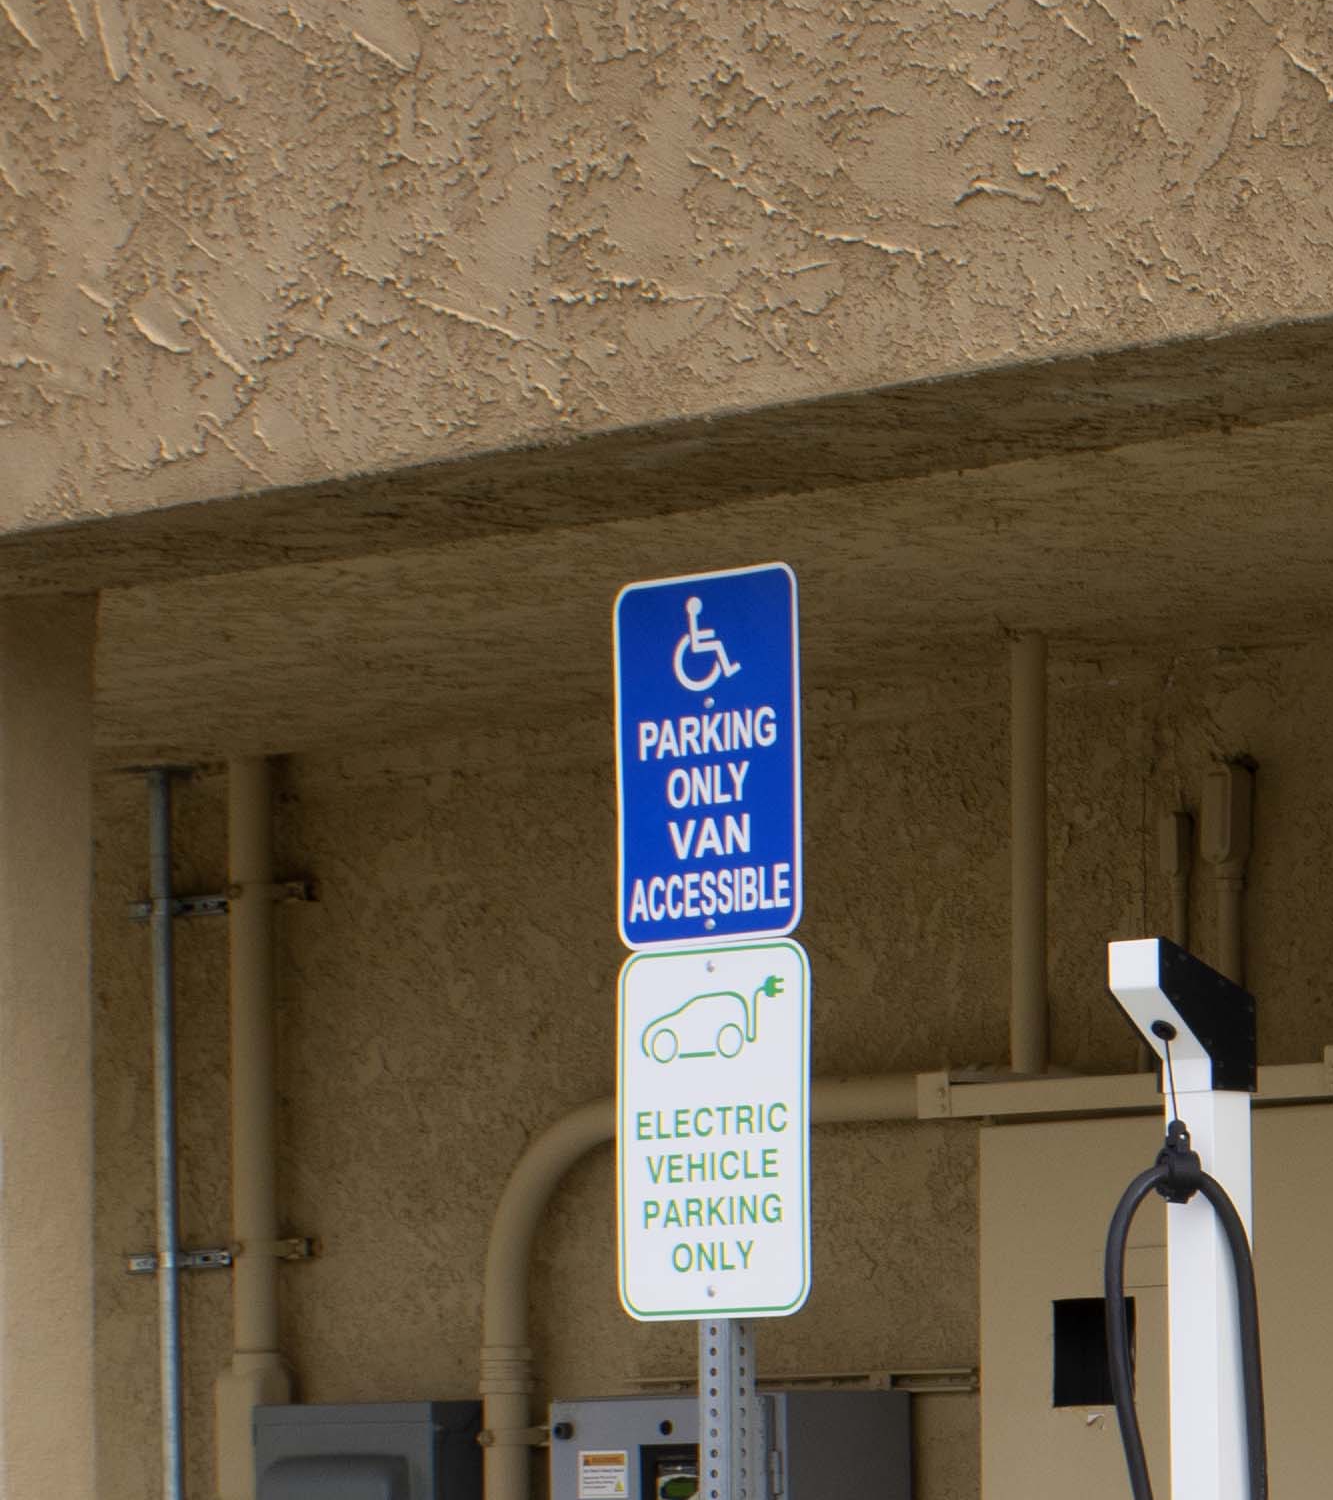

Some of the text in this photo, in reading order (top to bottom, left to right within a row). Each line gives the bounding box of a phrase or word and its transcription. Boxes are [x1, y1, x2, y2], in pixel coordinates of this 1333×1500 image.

[638, 706, 777, 761] PARKING
[666, 760, 750, 809] ONLY
[668, 813, 751, 860] VAN
[629, 863, 791, 923] ACCESSIBLE
[636, 1102, 789, 1141] ELECTRIC
[646, 1148, 779, 1184] VEHICLE
[644, 1193, 783, 1230] PARKING
[672, 1240, 755, 1273] ONLY
